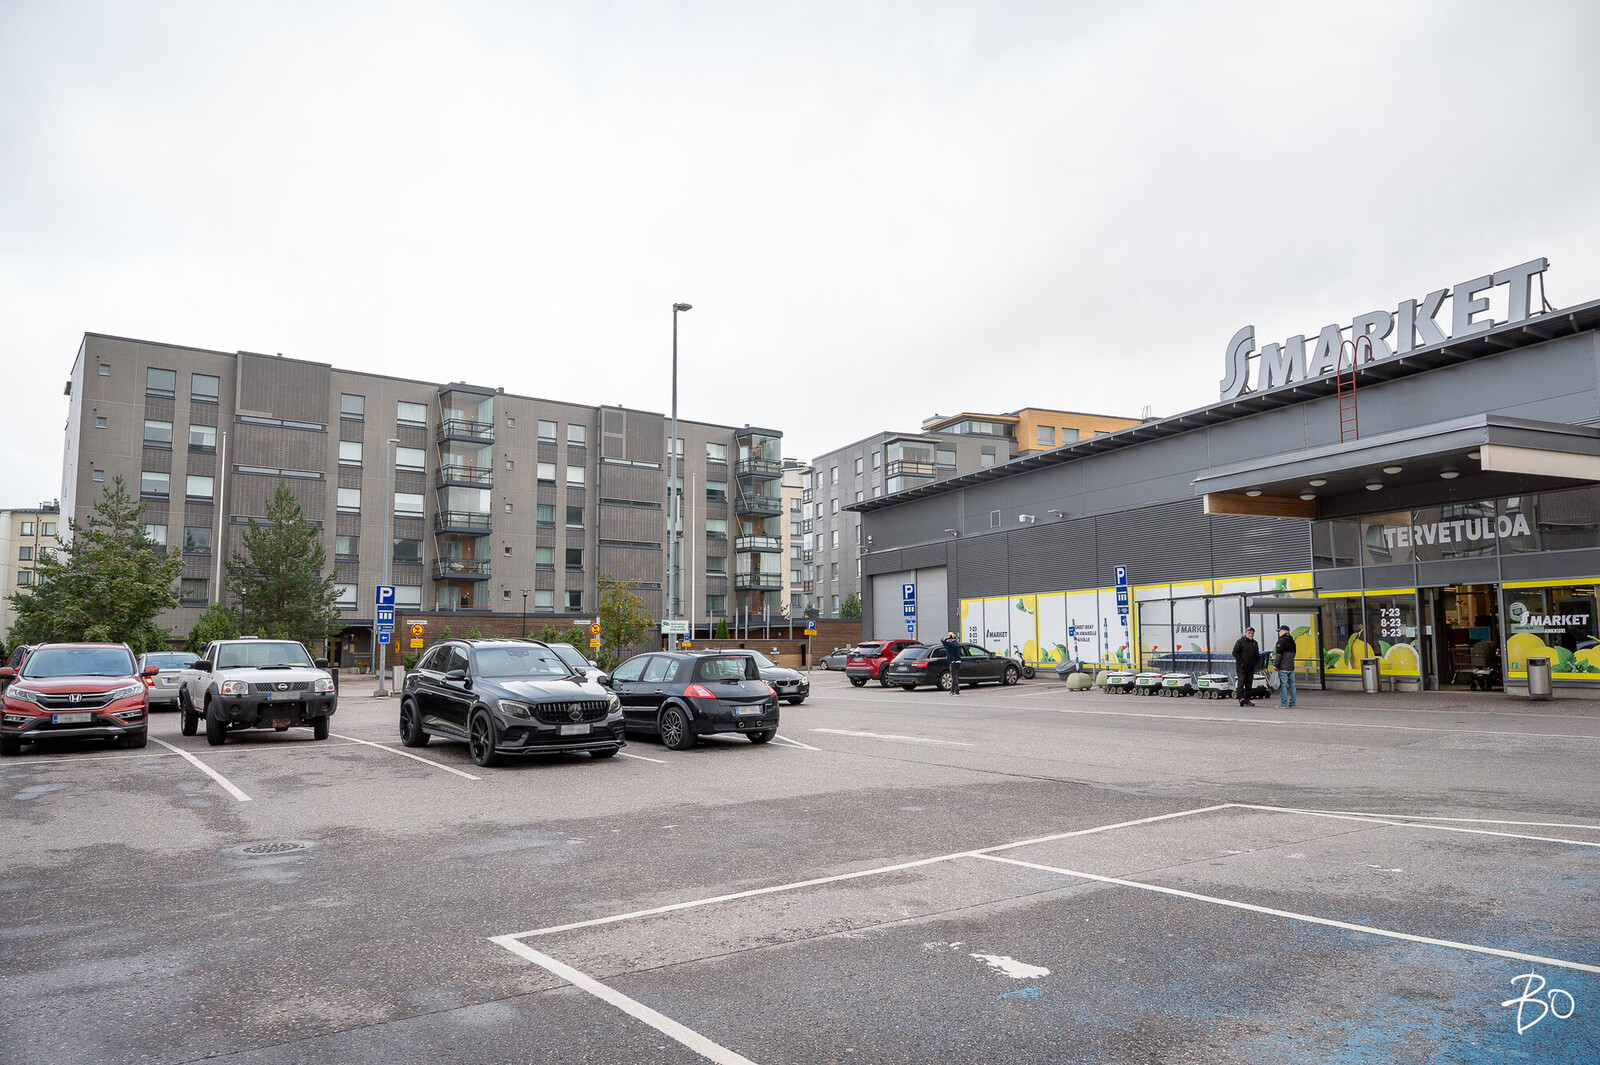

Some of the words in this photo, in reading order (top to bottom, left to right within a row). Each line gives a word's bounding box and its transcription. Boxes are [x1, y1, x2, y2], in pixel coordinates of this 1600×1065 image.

[1384, 513, 1531, 549] TERVETULOA
[1116, 567, 1125, 585] P
[379, 587, 393, 603] P
[905, 585, 914, 599] P
[1380, 608, 1401, 617] 7-23
[1380, 618, 1402, 627] 8-23
[1381, 628, 1402, 637] 9-23
